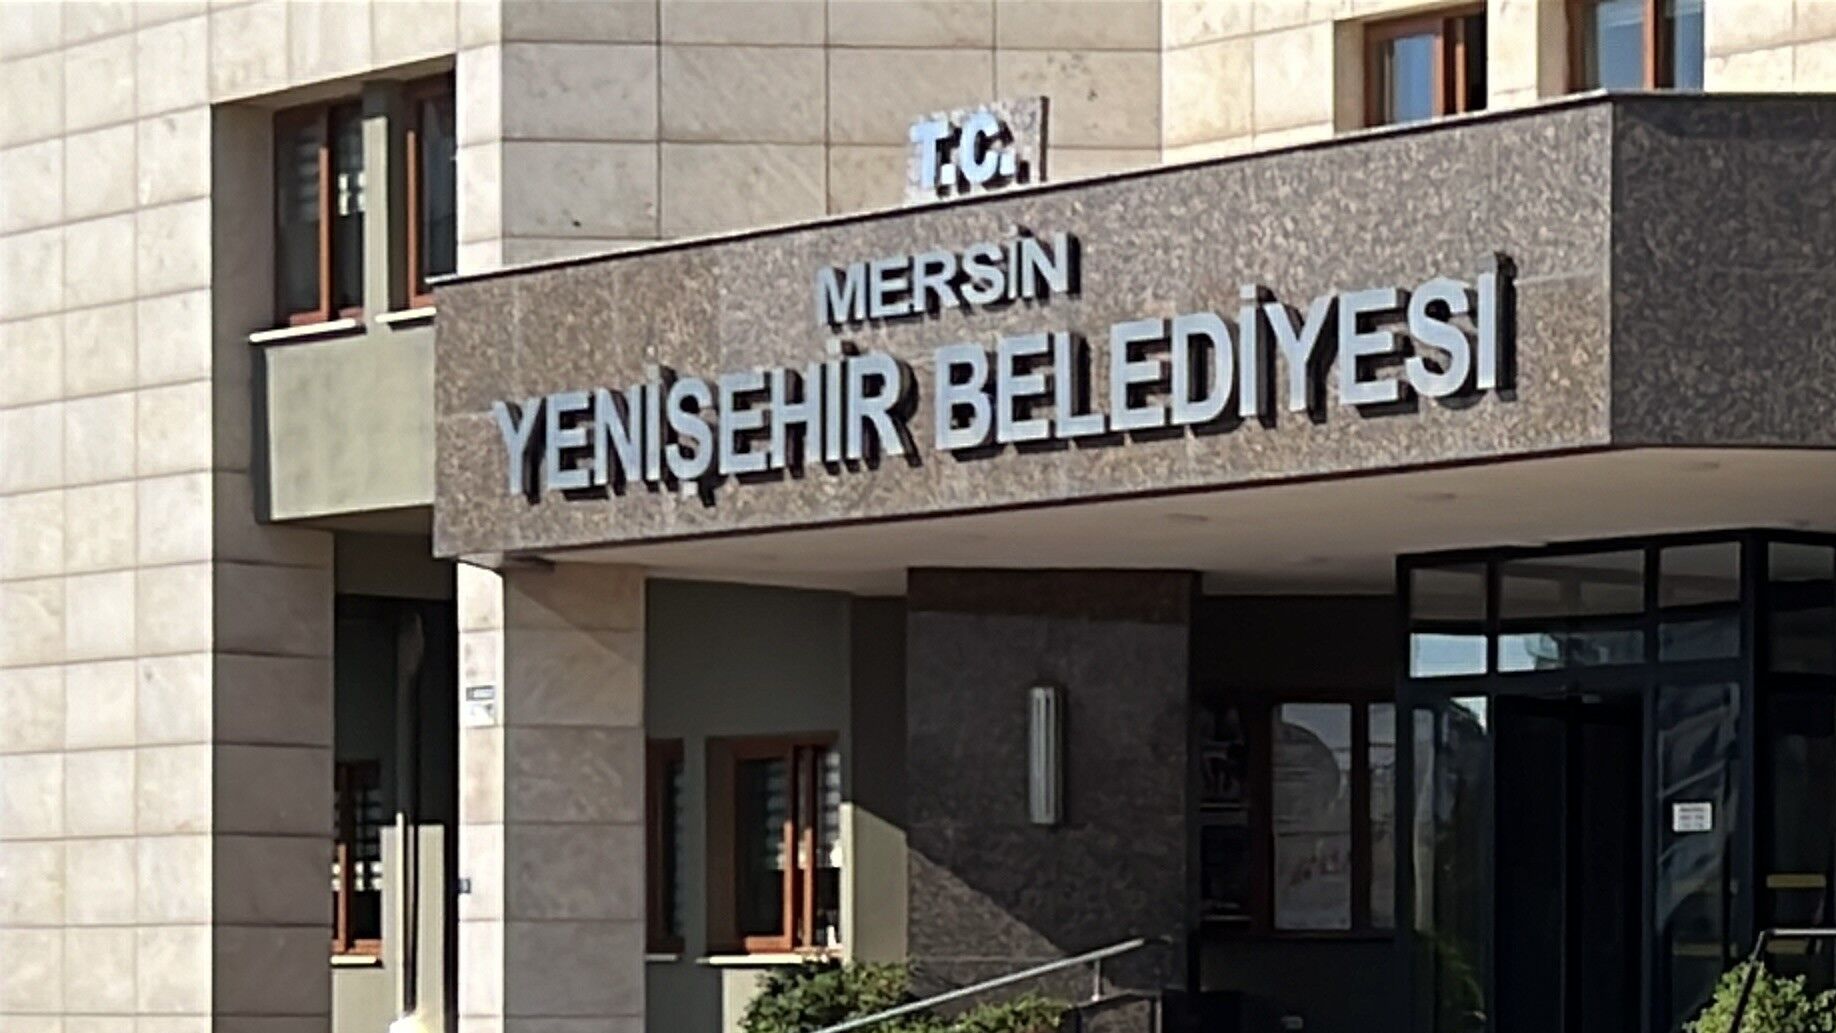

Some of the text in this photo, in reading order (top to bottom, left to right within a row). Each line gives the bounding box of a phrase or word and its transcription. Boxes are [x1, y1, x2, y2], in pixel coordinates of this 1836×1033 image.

[909, 106, 1016, 190] T.C.
[815, 224, 1072, 325] MERSİN
[493, 252, 1500, 497] YENİŞEHİR BELEDİYESİ
